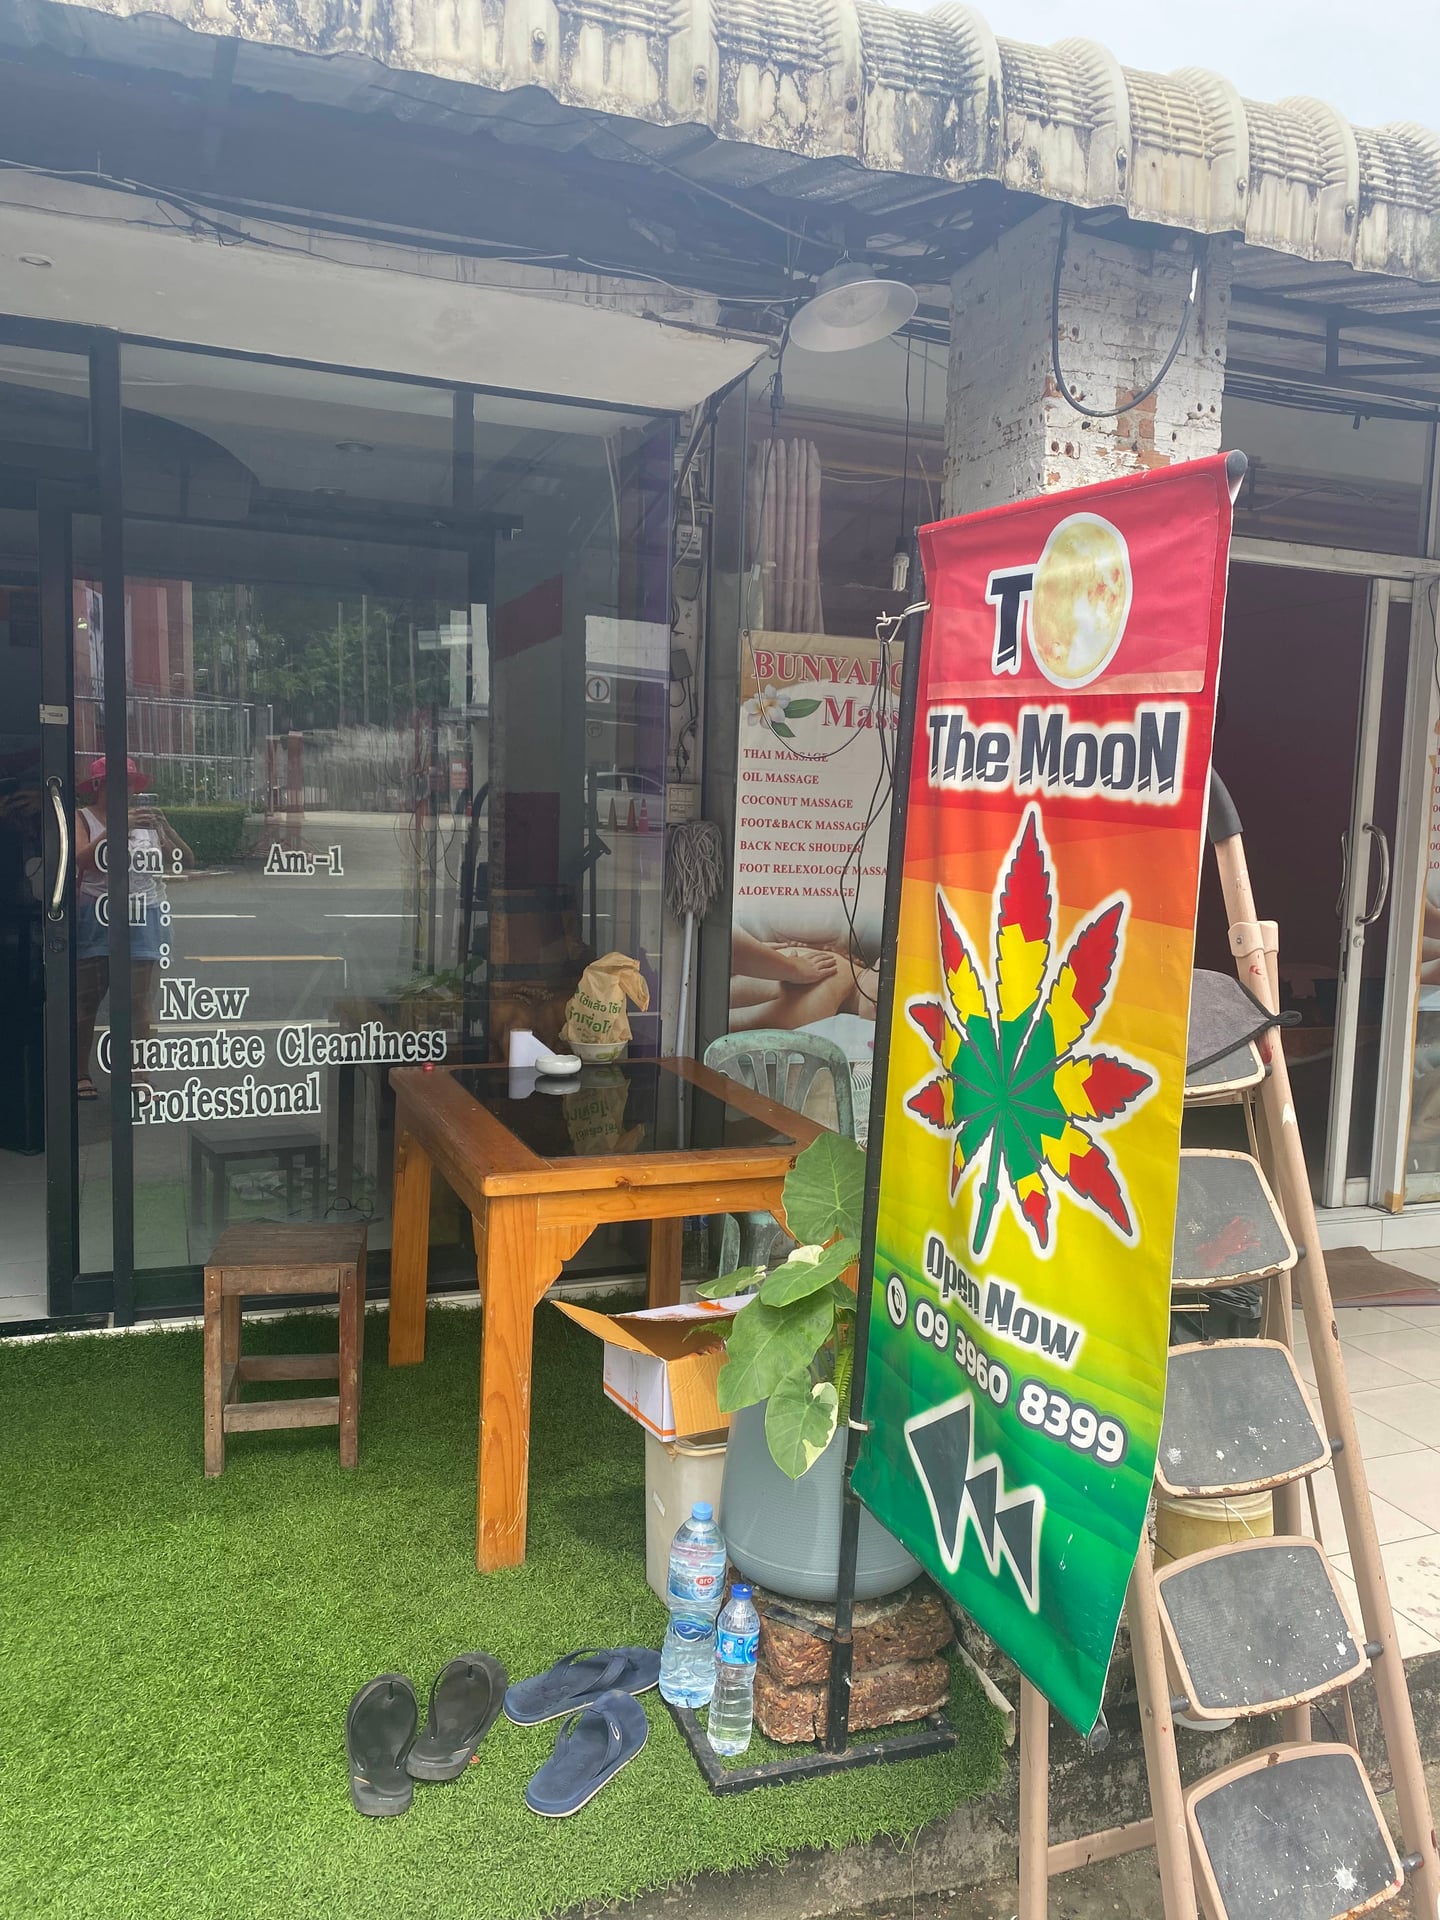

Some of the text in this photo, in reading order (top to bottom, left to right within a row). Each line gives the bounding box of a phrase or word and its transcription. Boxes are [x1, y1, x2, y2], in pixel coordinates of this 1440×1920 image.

[743, 748, 829, 763] THAI MASSAGE
[929, 712, 1010, 784] The
[742, 771, 820, 785] OIL MASSAGE
[741, 794, 854, 809] COCONUT MASSAGE
[740, 817, 813, 830] FOOT&BACK
[94, 839, 164, 874] Oen
[740, 840, 772, 851] BACK
[774, 841, 807, 853] NECK
[739, 863, 771, 874] FOOT
[94, 892, 147, 927] Cll
[738, 886, 855, 898] ALOEVERA MASSAGE
[159, 977, 250, 1020] New
[276, 1021, 447, 1066] Cleanliness
[131, 1071, 320, 1125] Professional
[927, 1236, 980, 1315] Open
[915, 1304, 1125, 1464] 09 3960 8399
